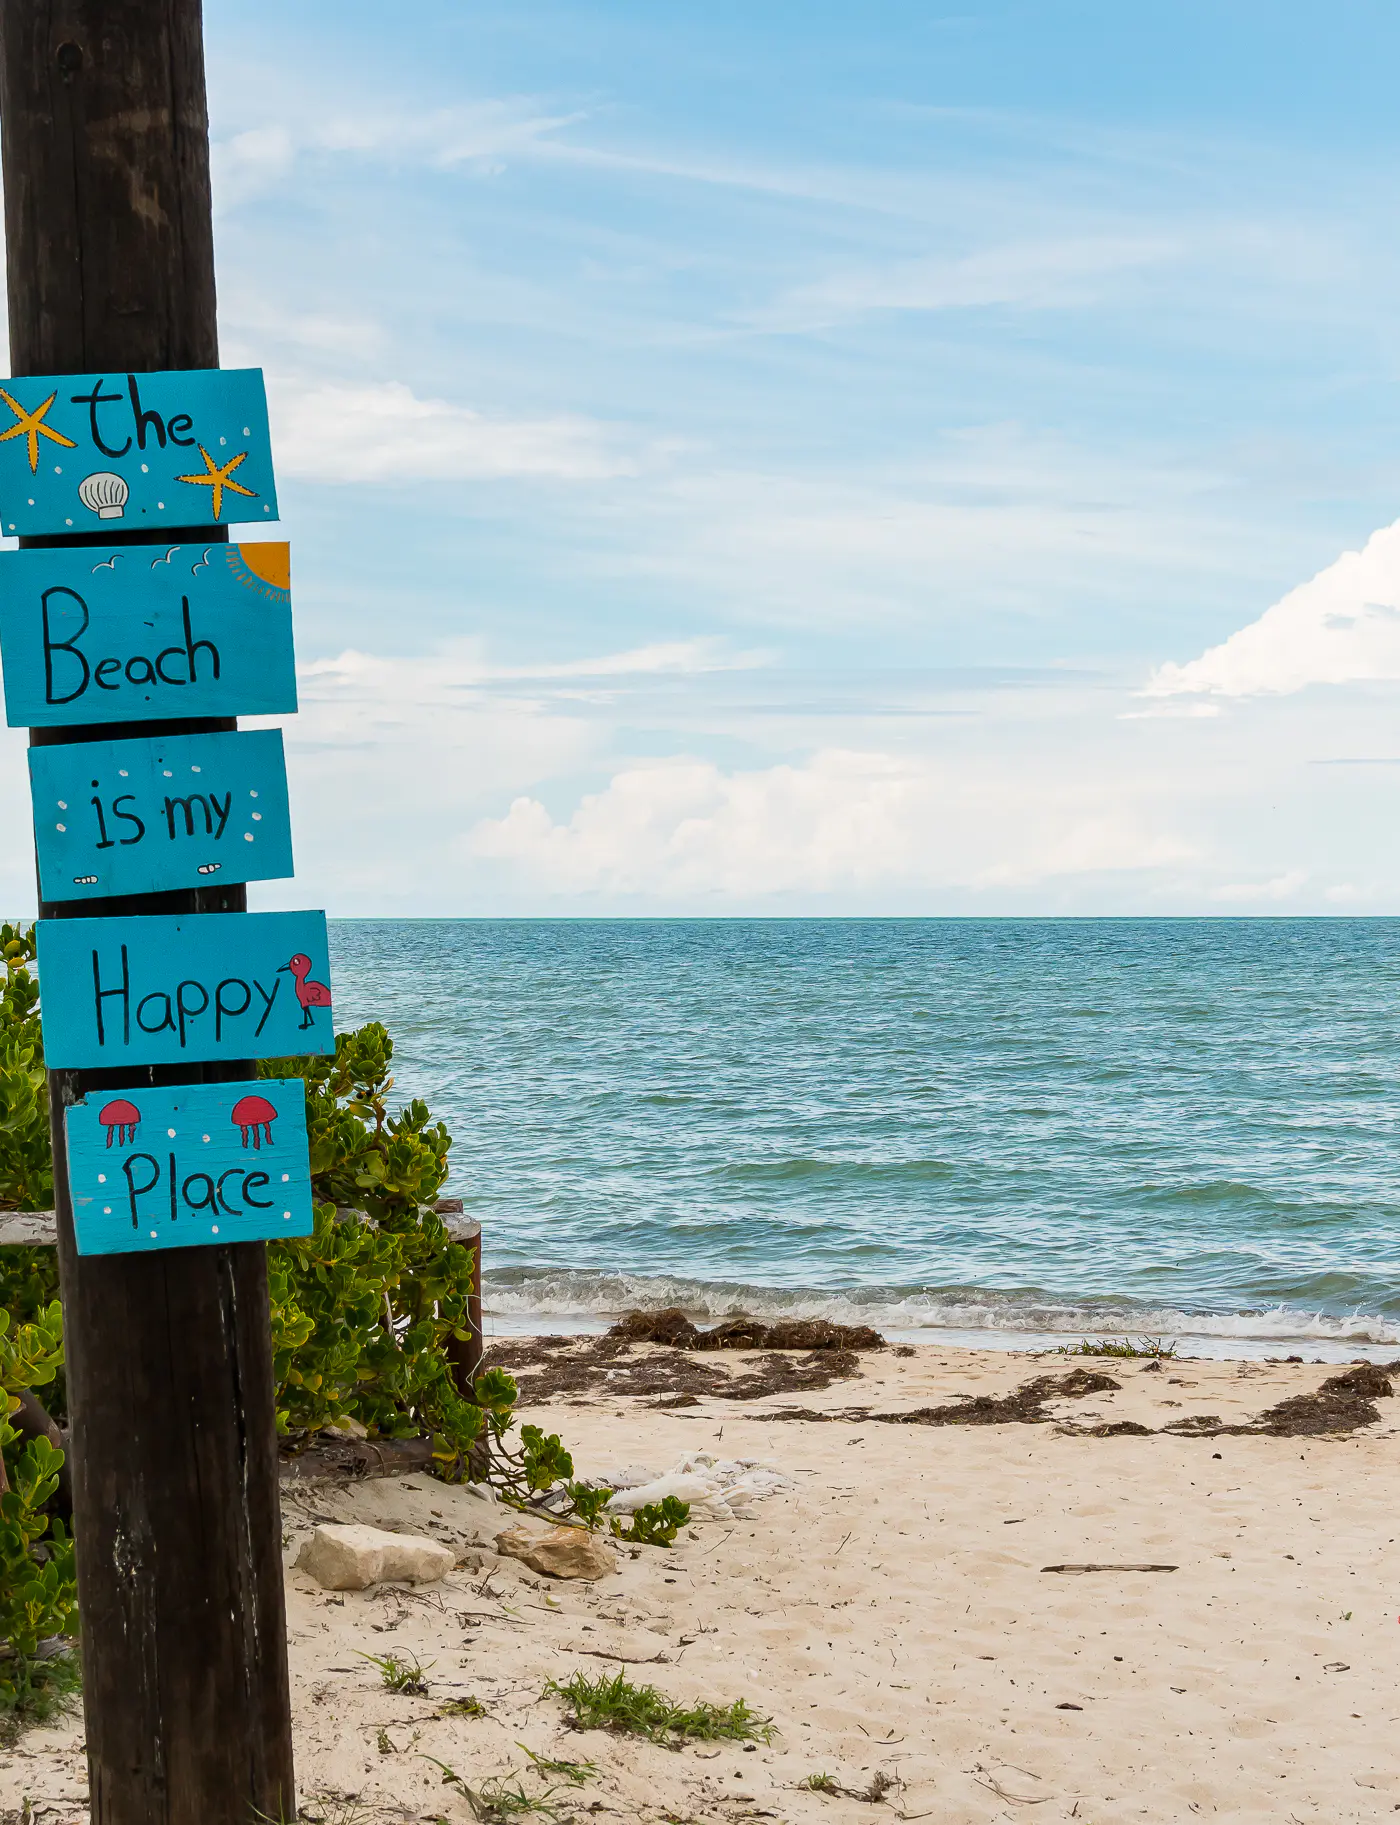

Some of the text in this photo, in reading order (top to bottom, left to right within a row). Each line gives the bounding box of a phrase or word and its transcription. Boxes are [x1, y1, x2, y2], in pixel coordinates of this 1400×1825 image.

[71, 375, 196, 458] the
[41, 586, 220, 705] Beach
[91, 779, 232, 849] is my
[92, 944, 281, 1048] Happy
[122, 1152, 275, 1230] Place
